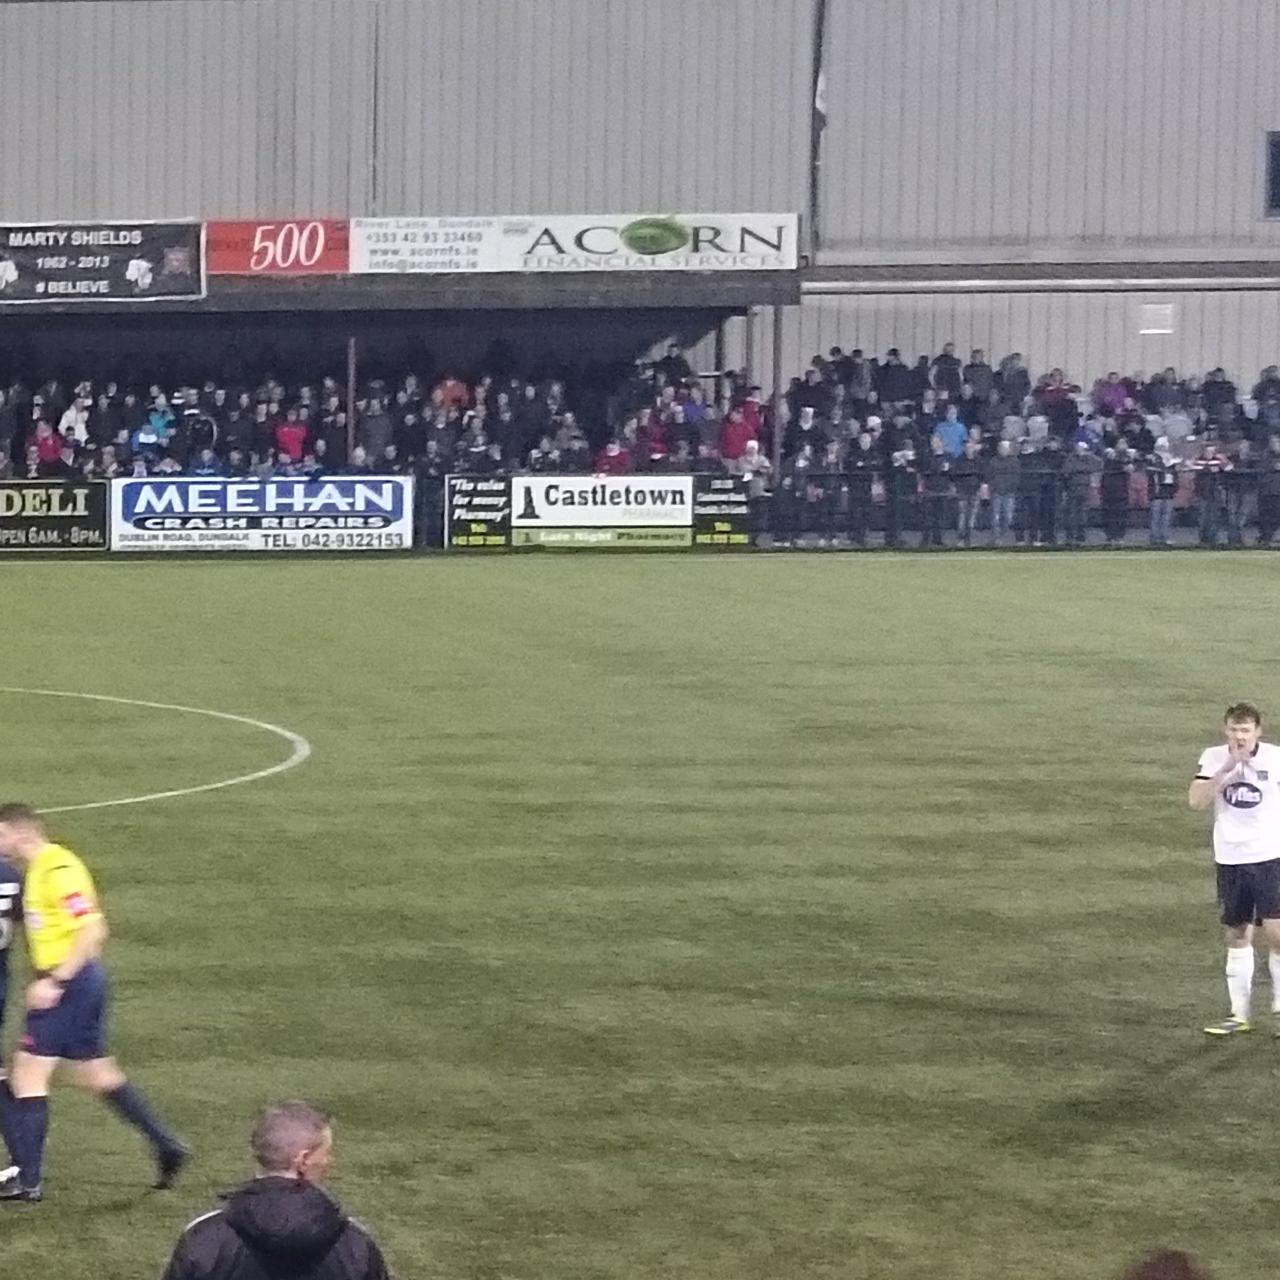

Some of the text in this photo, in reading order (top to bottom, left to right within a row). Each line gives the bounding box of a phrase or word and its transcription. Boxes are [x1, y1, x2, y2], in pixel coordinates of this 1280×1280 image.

[8, 230, 143, 247] MARTY SHIELDS
[249, 221, 326, 271] 500
[525, 217, 787, 256] ACORN
[46, 280, 110, 294] BELIEVE
[133, 483, 394, 513] MEEHAN
[544, 483, 686, 507] Castletown
[144, 515, 386, 529] CRASH REPAIRS
